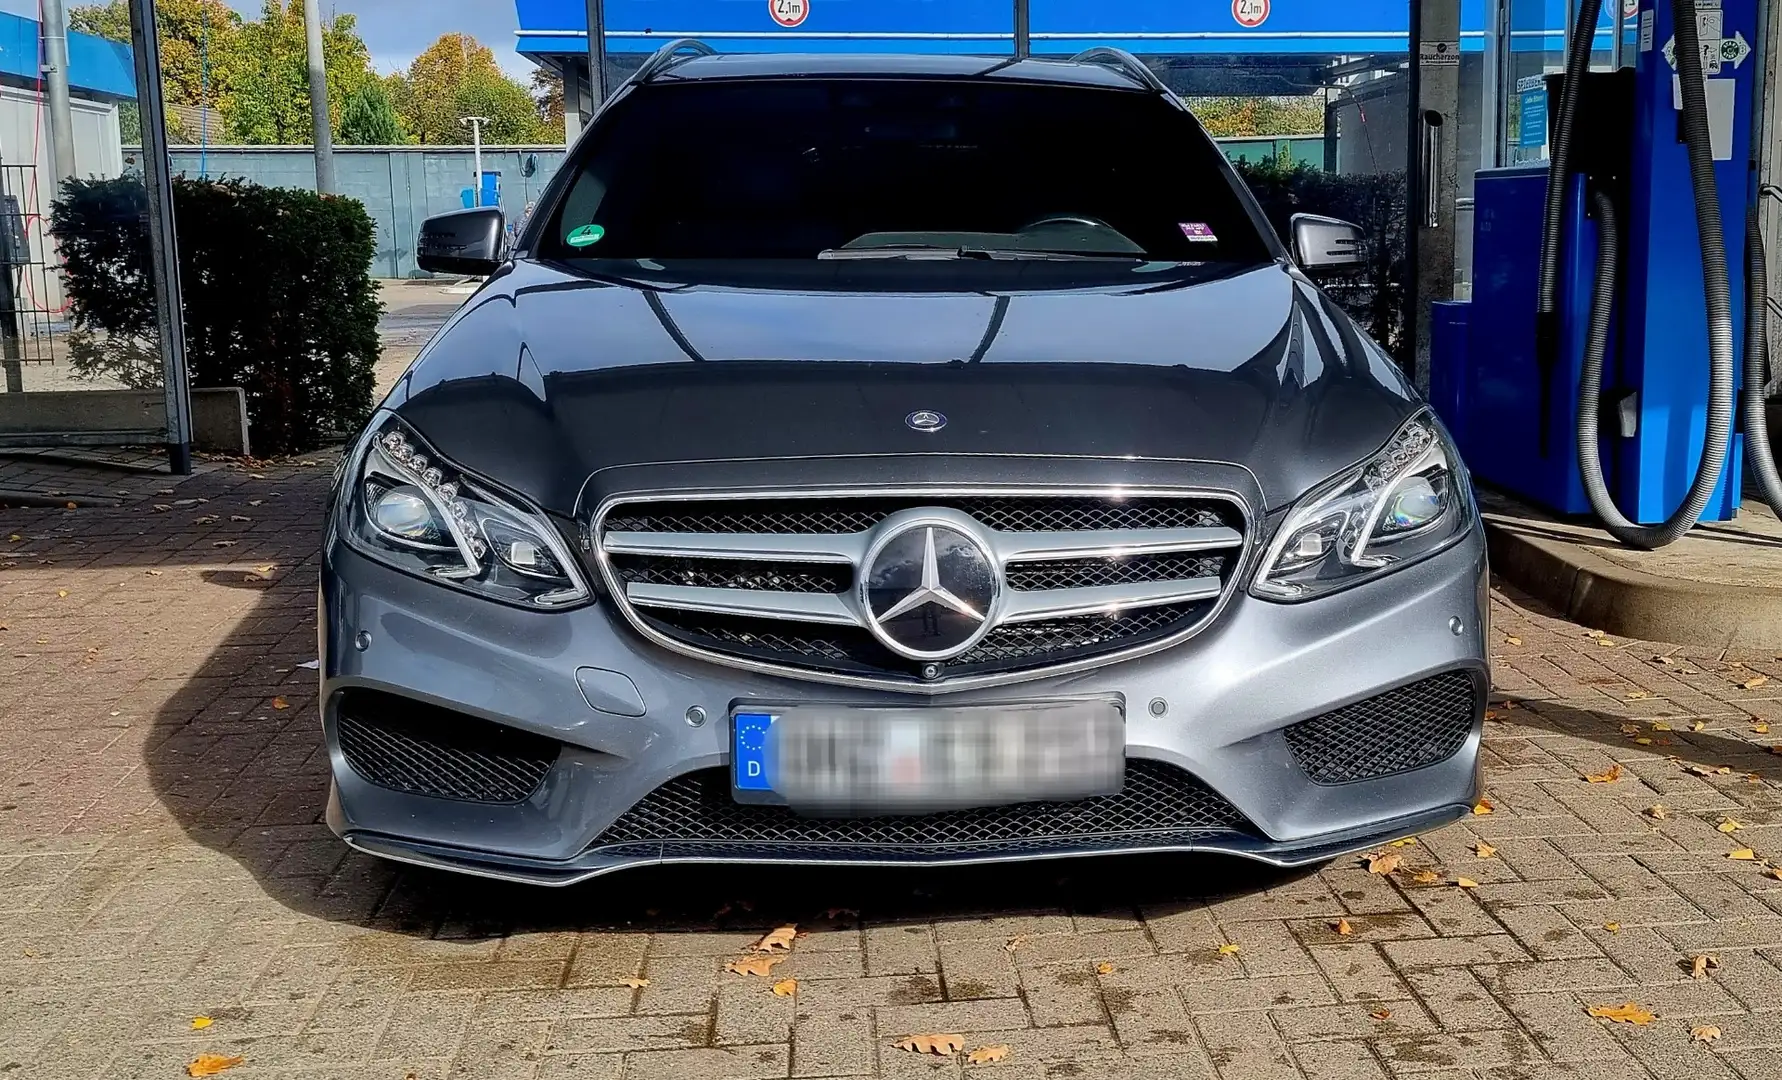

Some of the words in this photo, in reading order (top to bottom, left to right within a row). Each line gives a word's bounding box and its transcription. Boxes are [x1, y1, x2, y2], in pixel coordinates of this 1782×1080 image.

[777, 0, 801, 14] 2,1m
[1240, 0, 1262, 15] 2,1m
[581, 225, 592, 235] 4
[748, 760, 760, 776] D
